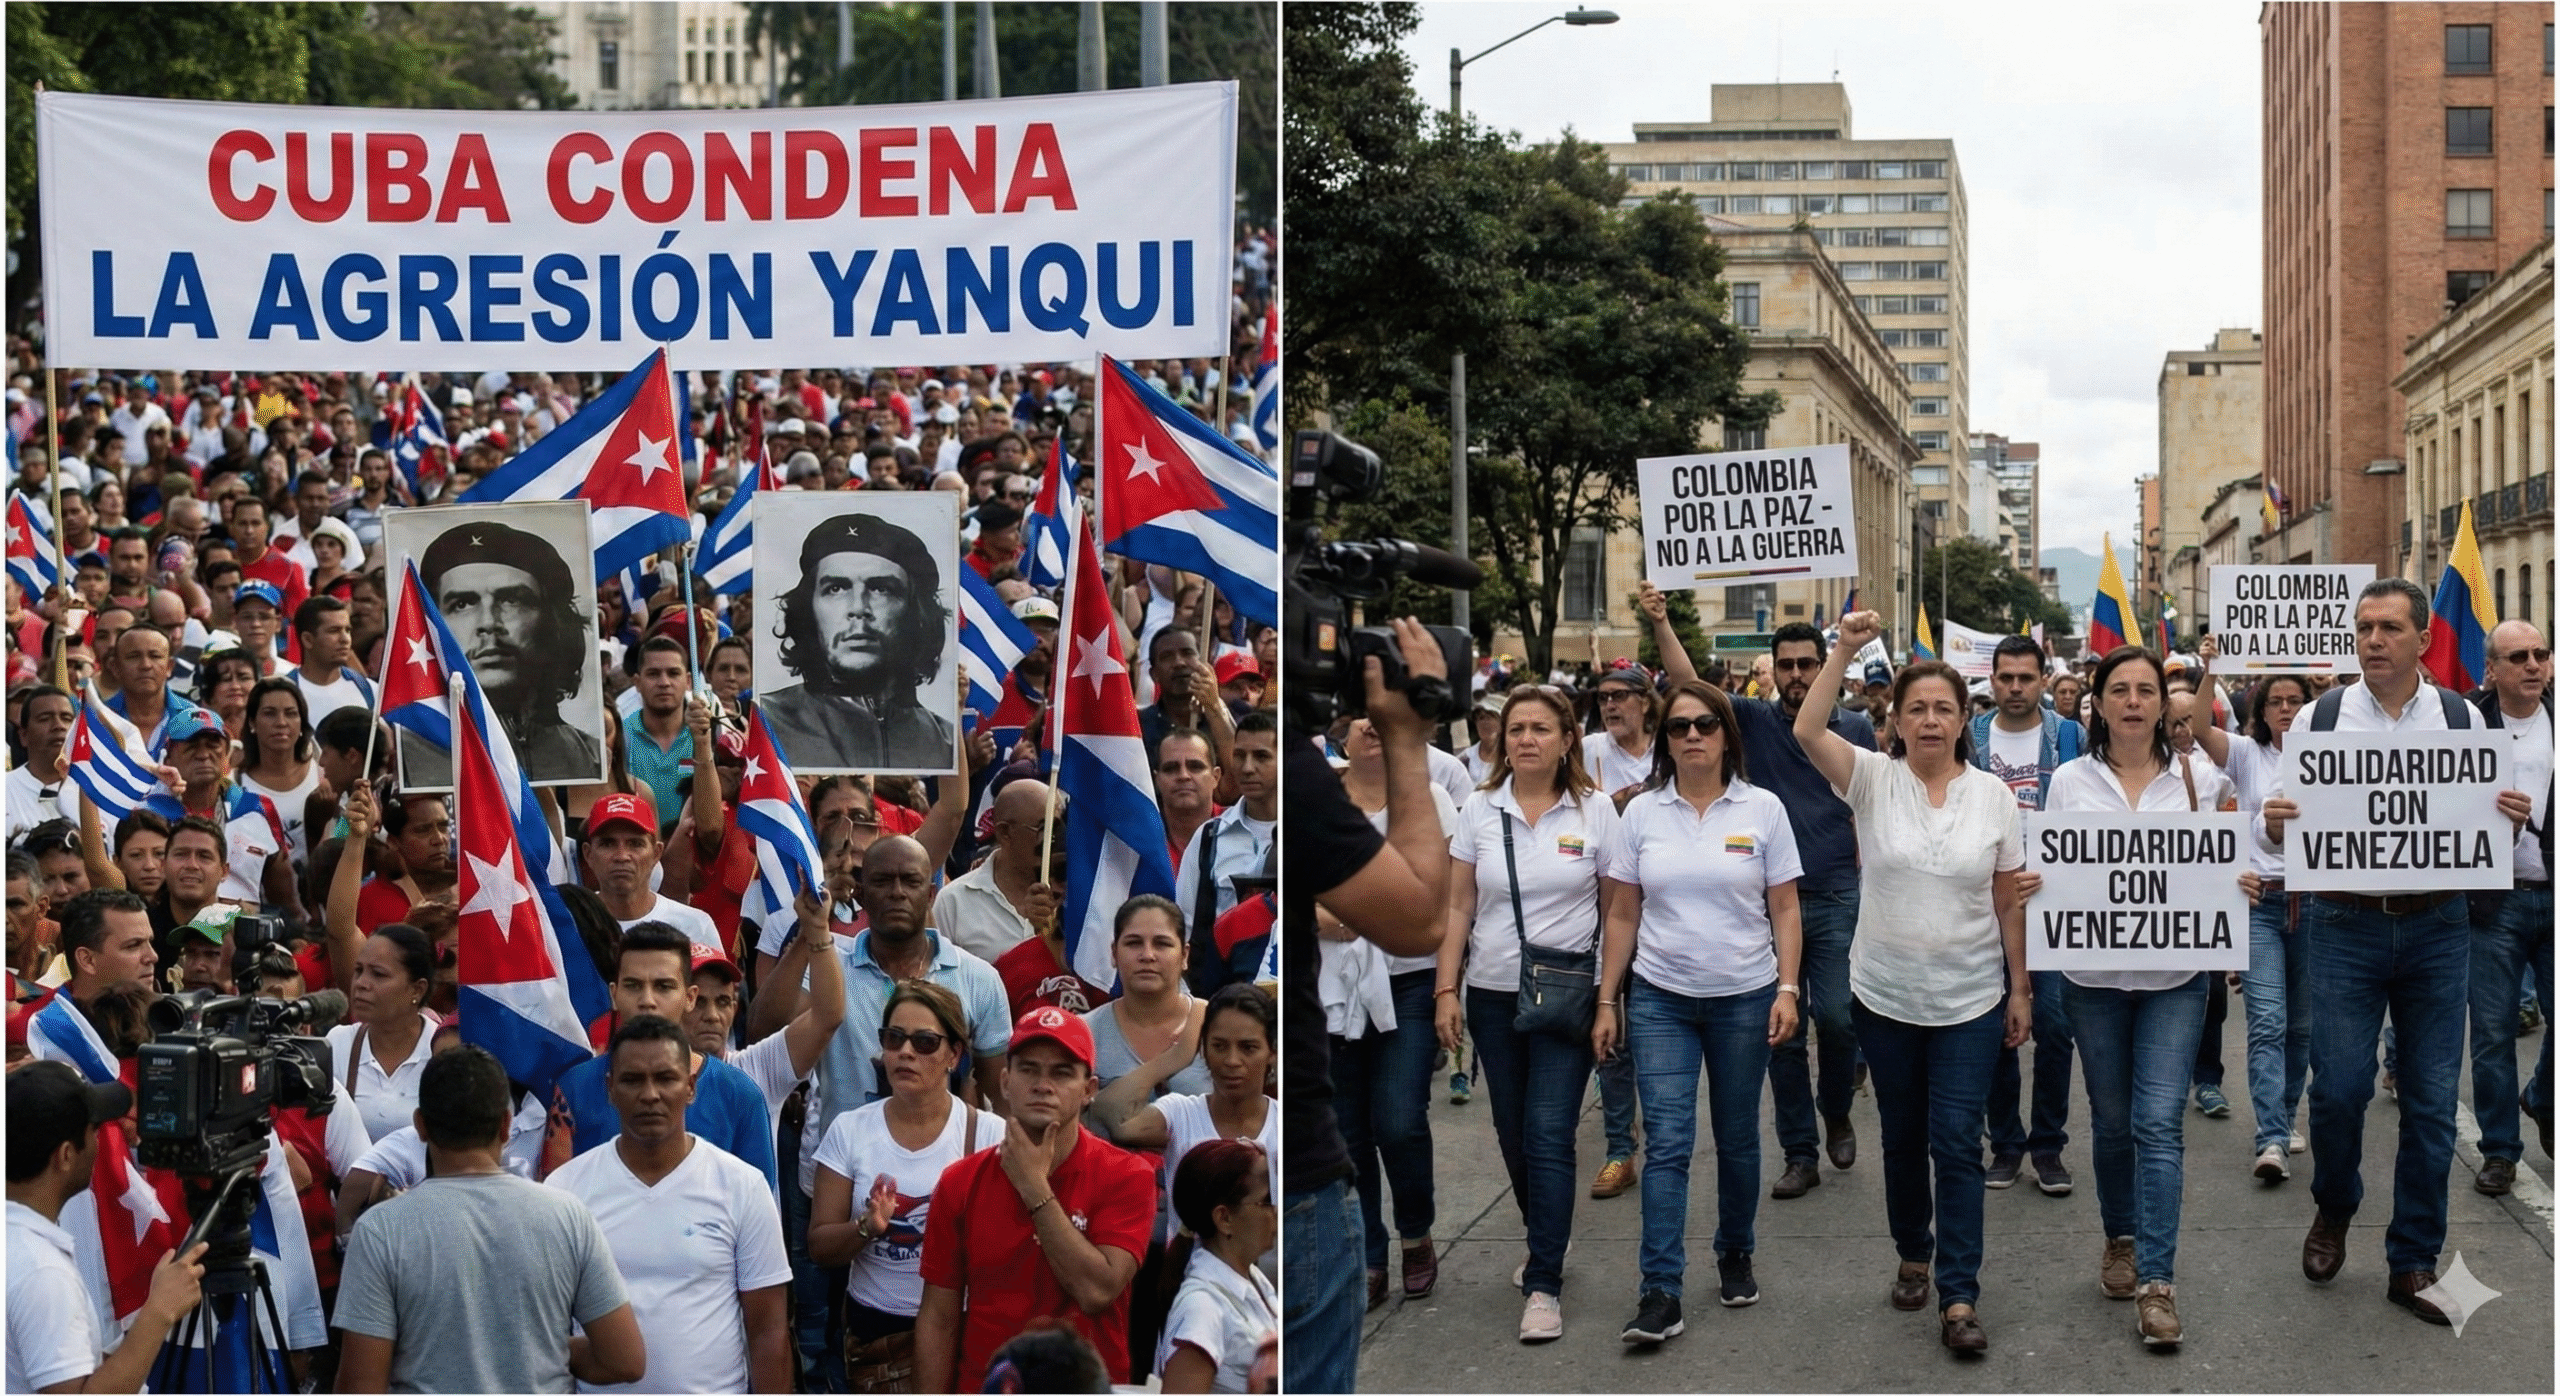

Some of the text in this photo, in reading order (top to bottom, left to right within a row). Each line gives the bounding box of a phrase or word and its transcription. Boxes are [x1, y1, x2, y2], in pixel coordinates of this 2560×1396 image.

[208, 122, 1077, 223] CUBA CONDENA
[92, 230, 1194, 343] LA AGRESIÓN YANQUI
[1672, 456, 1817, 499] COLOMBIA
[1664, 498, 1716, 534] POR
[1723, 498, 1756, 530] LA
[1763, 494, 1814, 527] PAZ
[1656, 527, 1845, 567] NO A LA GUERRA
[2236, 573, 2349, 600] COLOMBIA
[2226, 603, 2346, 628] POR LA PAZ
[2217, 632, 2355, 655] NO A LA GUERR
[2299, 747, 2496, 786] SOLIDARIDAD
[2368, 790, 2427, 825] CON
[2041, 828, 2235, 864] SOLIDARIDAD
[2302, 830, 2493, 869] VENEZUELA
[2108, 869, 2166, 905] CON
[2043, 910, 2232, 949] VENEZUELA
